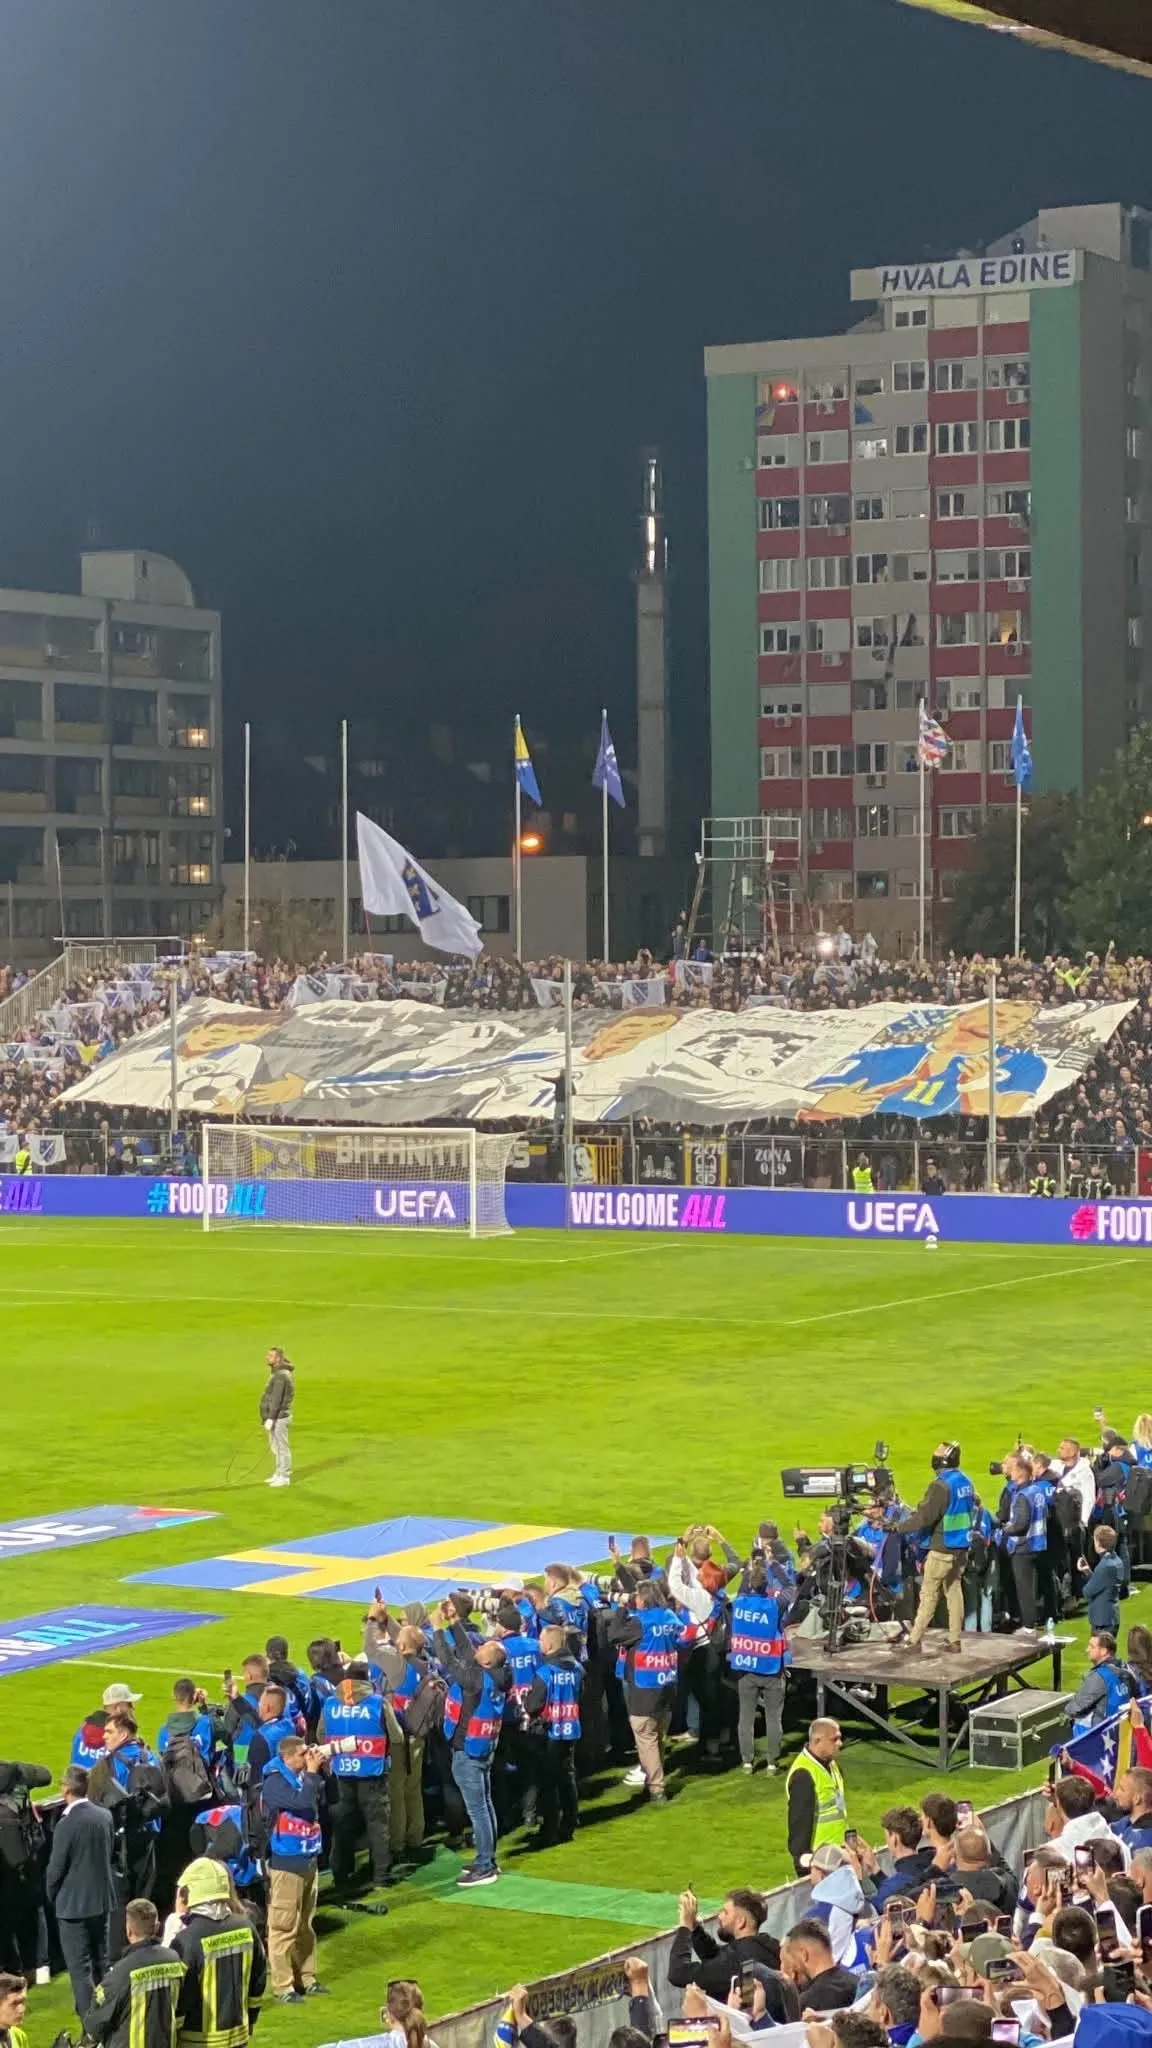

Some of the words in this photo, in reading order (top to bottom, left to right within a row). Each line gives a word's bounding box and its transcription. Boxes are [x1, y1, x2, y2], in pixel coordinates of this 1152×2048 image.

[882, 264, 971, 292] HVALA
[980, 253, 1071, 286] EDINE
[3, 1181, 43, 1211] ALL
[376, 1190, 456, 1219] UEFA
[571, 1191, 679, 1226] WELCOME
[681, 1194, 727, 1228] ALL
[847, 1202, 940, 1233] UEFA
[735, 1608, 769, 1624] UEFA
[736, 1654, 758, 1668] 041
[331, 1705, 371, 1720] UEFA
